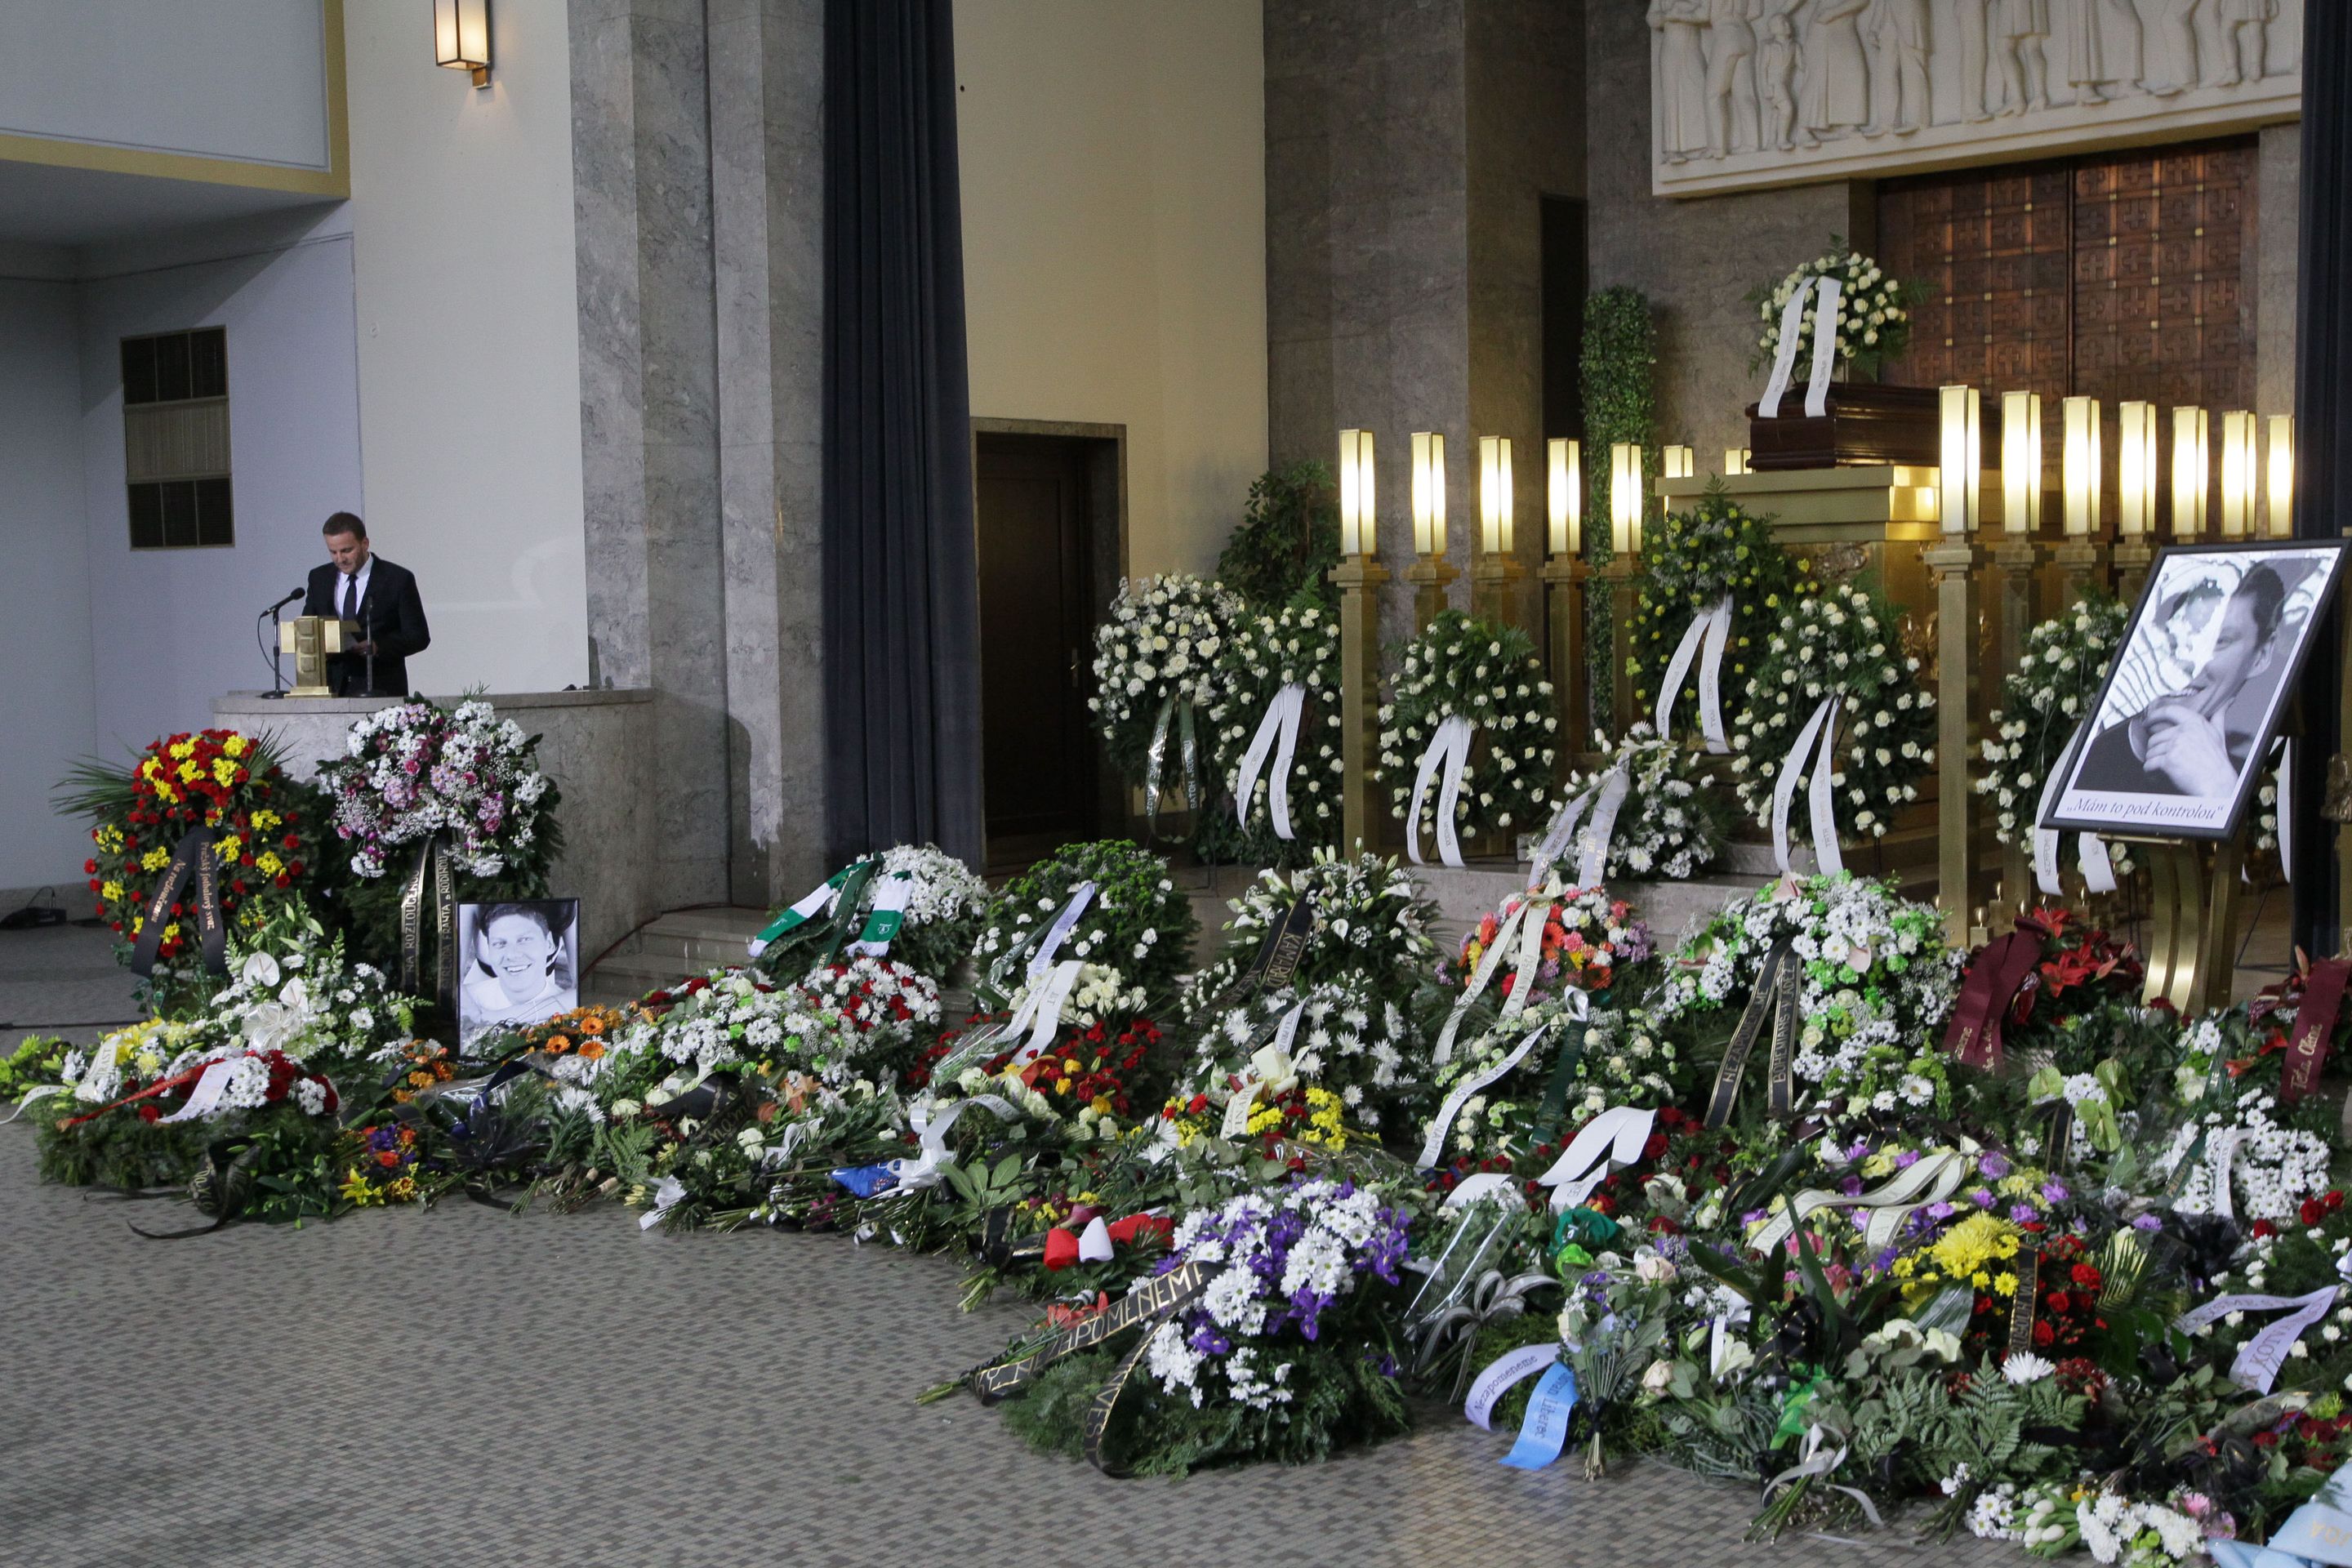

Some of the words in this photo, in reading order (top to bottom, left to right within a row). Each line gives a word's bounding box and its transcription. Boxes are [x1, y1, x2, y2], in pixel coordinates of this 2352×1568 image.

[2110, 801, 2123, 813] to
[2123, 800, 2152, 819] pod
[174, 858, 187, 874] Na
[206, 911, 216, 931] svaz
[1473, 1354, 1539, 1415] Nezapomeneme
[1534, 1396, 1559, 1439] Liberec
